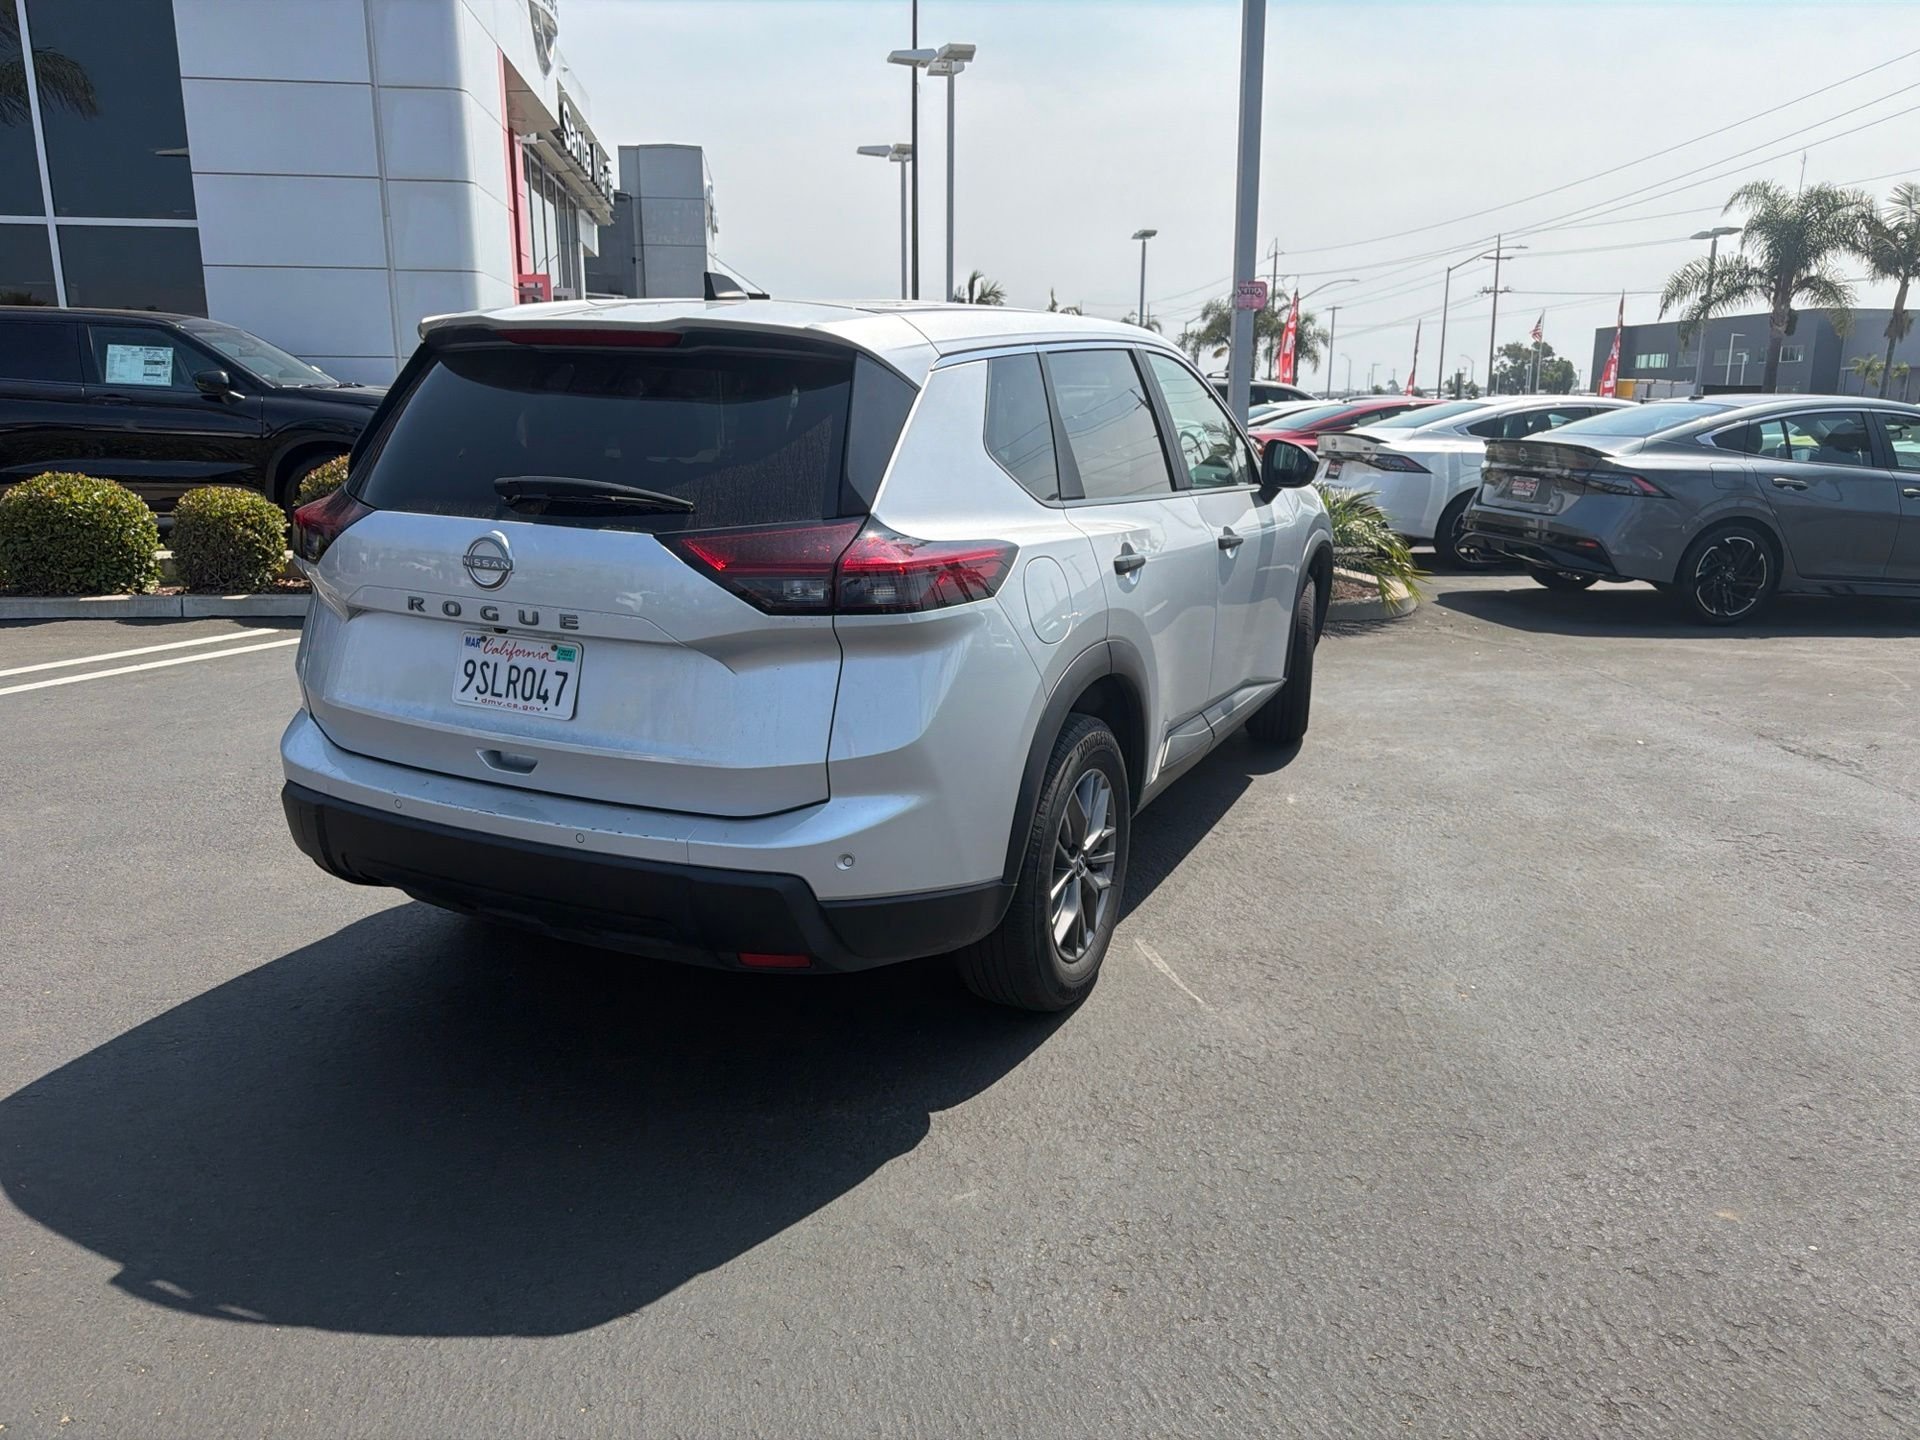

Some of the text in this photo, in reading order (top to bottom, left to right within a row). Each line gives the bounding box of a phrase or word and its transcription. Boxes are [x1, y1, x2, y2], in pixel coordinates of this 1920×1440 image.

[562, 101, 592, 179] Santa
[463, 556, 511, 569] NISSAN
[407, 596, 579, 630] ROGUE
[465, 636, 481, 648] MAR
[483, 638, 556, 662] California
[461, 659, 568, 707] 9SLR047
[481, 698, 541, 711] dmv.ca.gov
